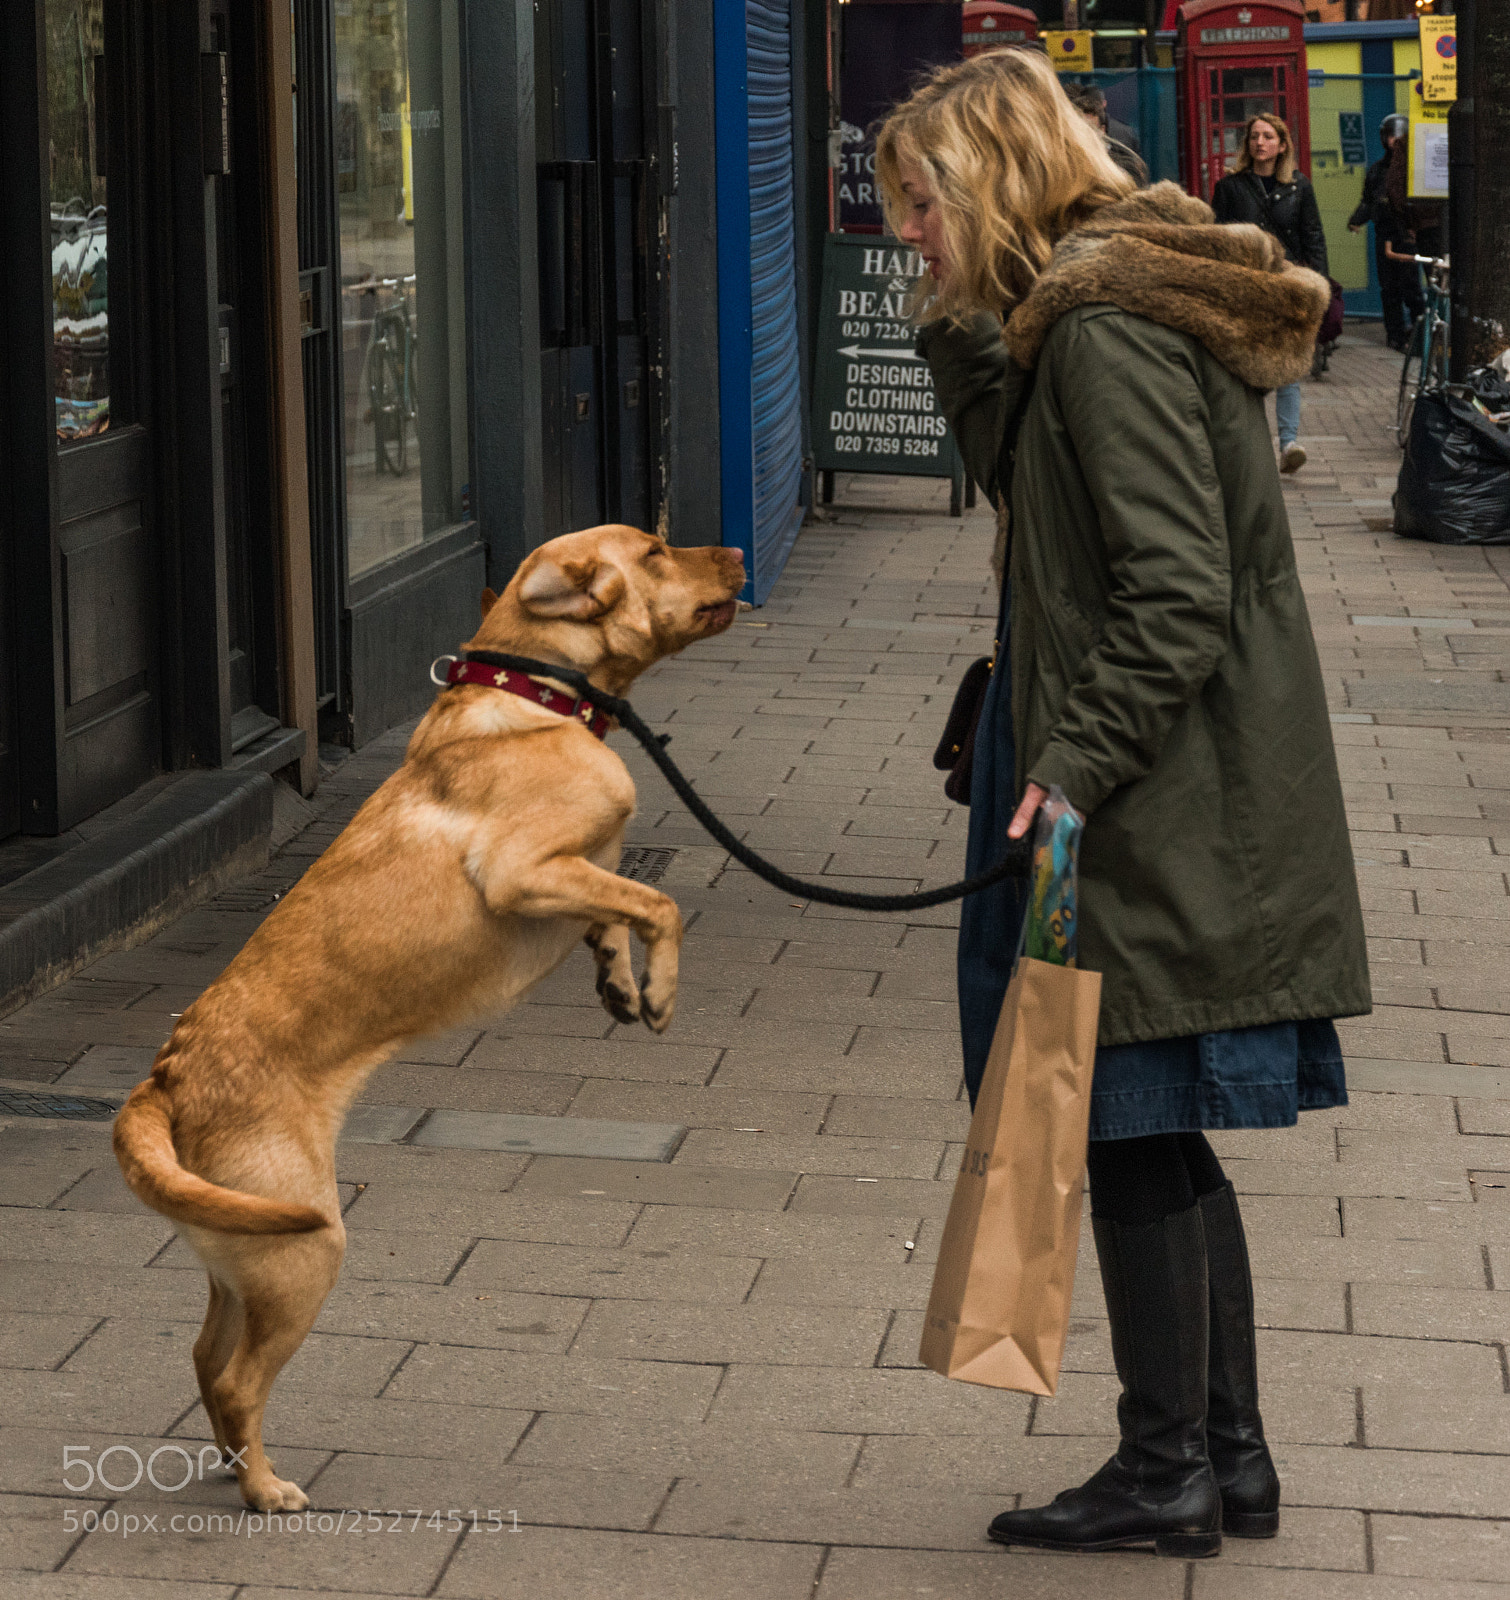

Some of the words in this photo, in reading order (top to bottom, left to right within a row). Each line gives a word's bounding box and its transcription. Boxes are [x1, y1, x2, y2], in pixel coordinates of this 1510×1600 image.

[888, 277, 908, 292] &
[837, 290, 940, 320] BEAU
[842, 321, 870, 338] 020
[874, 322, 909, 340] 7226
[846, 387, 935, 412] CLOTHING
[830, 411, 947, 437] DOWNSTAIRS
[835, 435, 862, 452] 020
[865, 437, 900, 454] 7359
[904, 438, 939, 456] 5284
